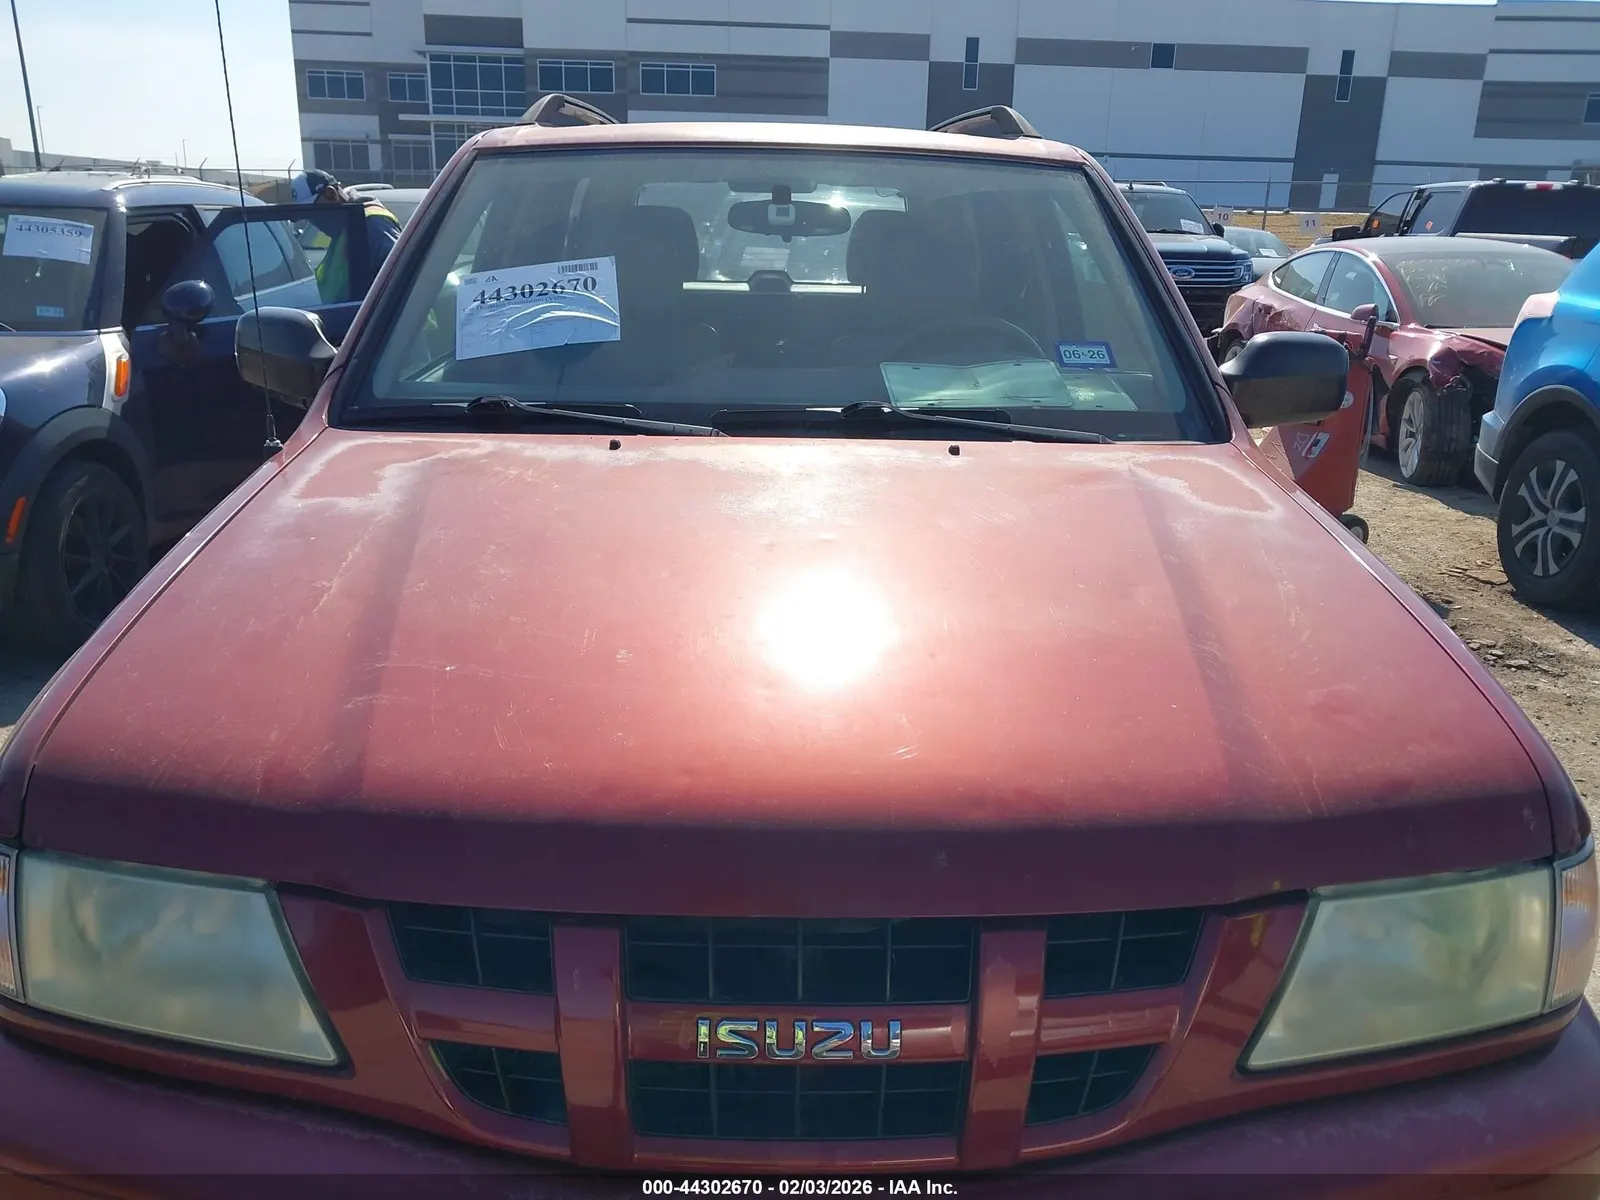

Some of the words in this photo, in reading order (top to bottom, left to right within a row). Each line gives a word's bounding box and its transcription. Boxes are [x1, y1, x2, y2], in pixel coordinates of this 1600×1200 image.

[1217, 213, 1229, 221] 10
[1304, 219, 1316, 228] 11
[473, 276, 597, 305] 44302670
[697, 1018, 901, 1060] ISUZU
